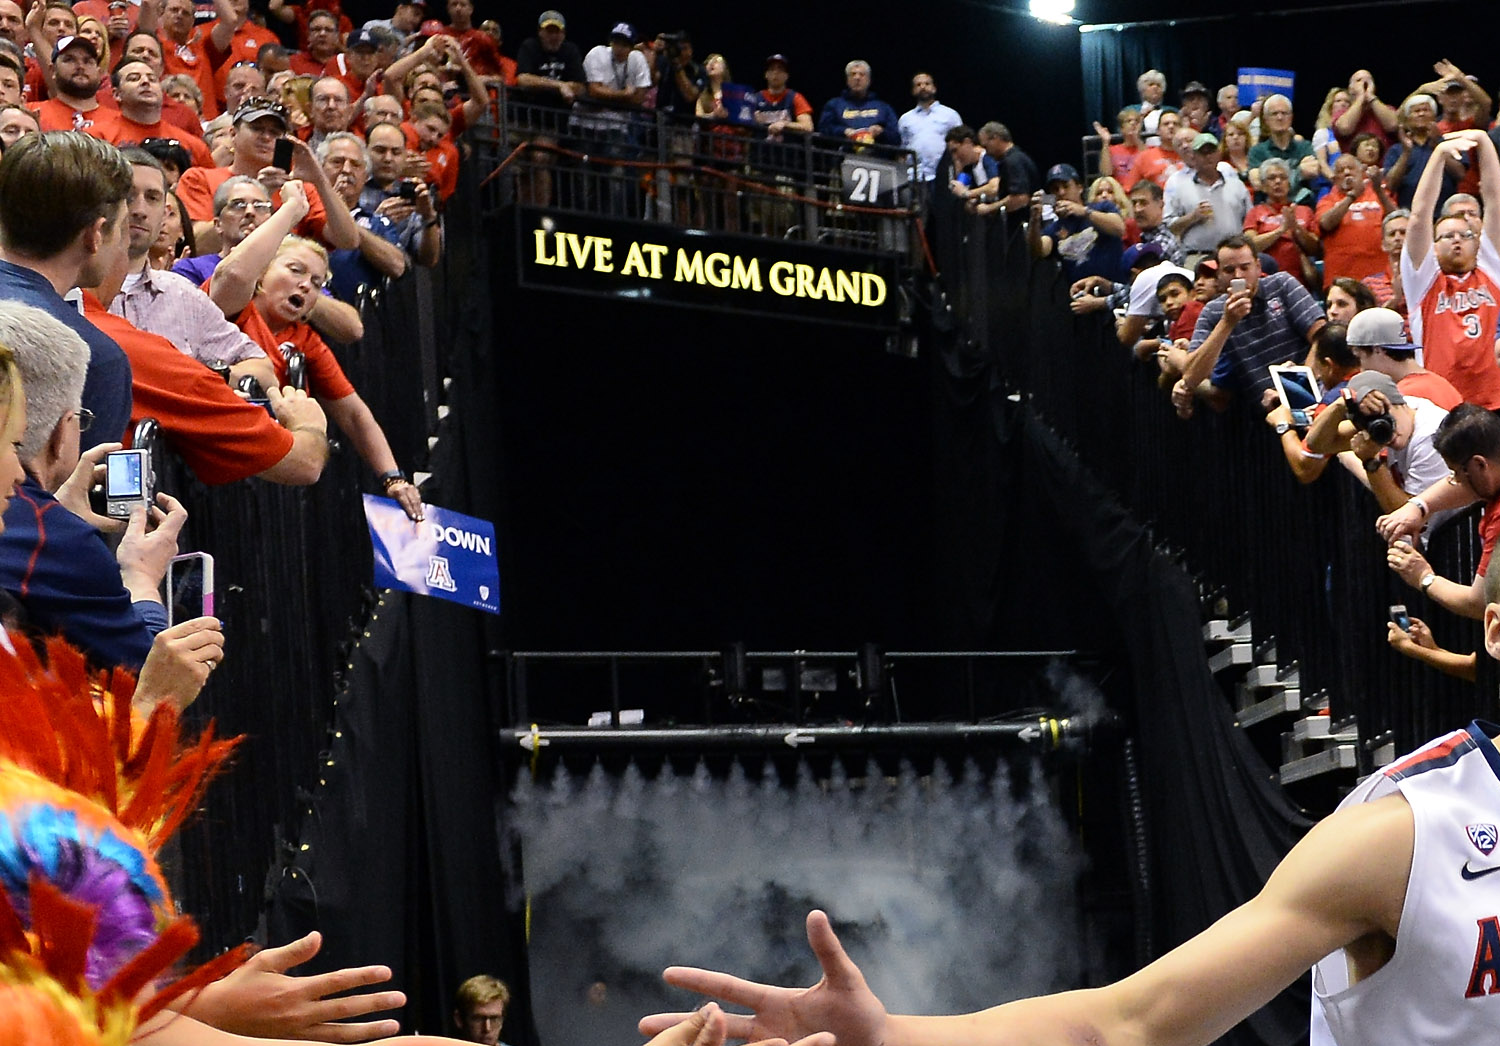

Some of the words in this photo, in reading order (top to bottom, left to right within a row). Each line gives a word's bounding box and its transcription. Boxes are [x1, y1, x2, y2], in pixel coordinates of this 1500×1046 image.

[849, 168, 882, 203] 21
[533, 229, 614, 273] LIVE
[621, 241, 668, 279] AT
[674, 248, 763, 292] MGM
[768, 260, 887, 307] GRAND
[1462, 313, 1482, 339] 3
[1477, 834, 1493, 849] 12
